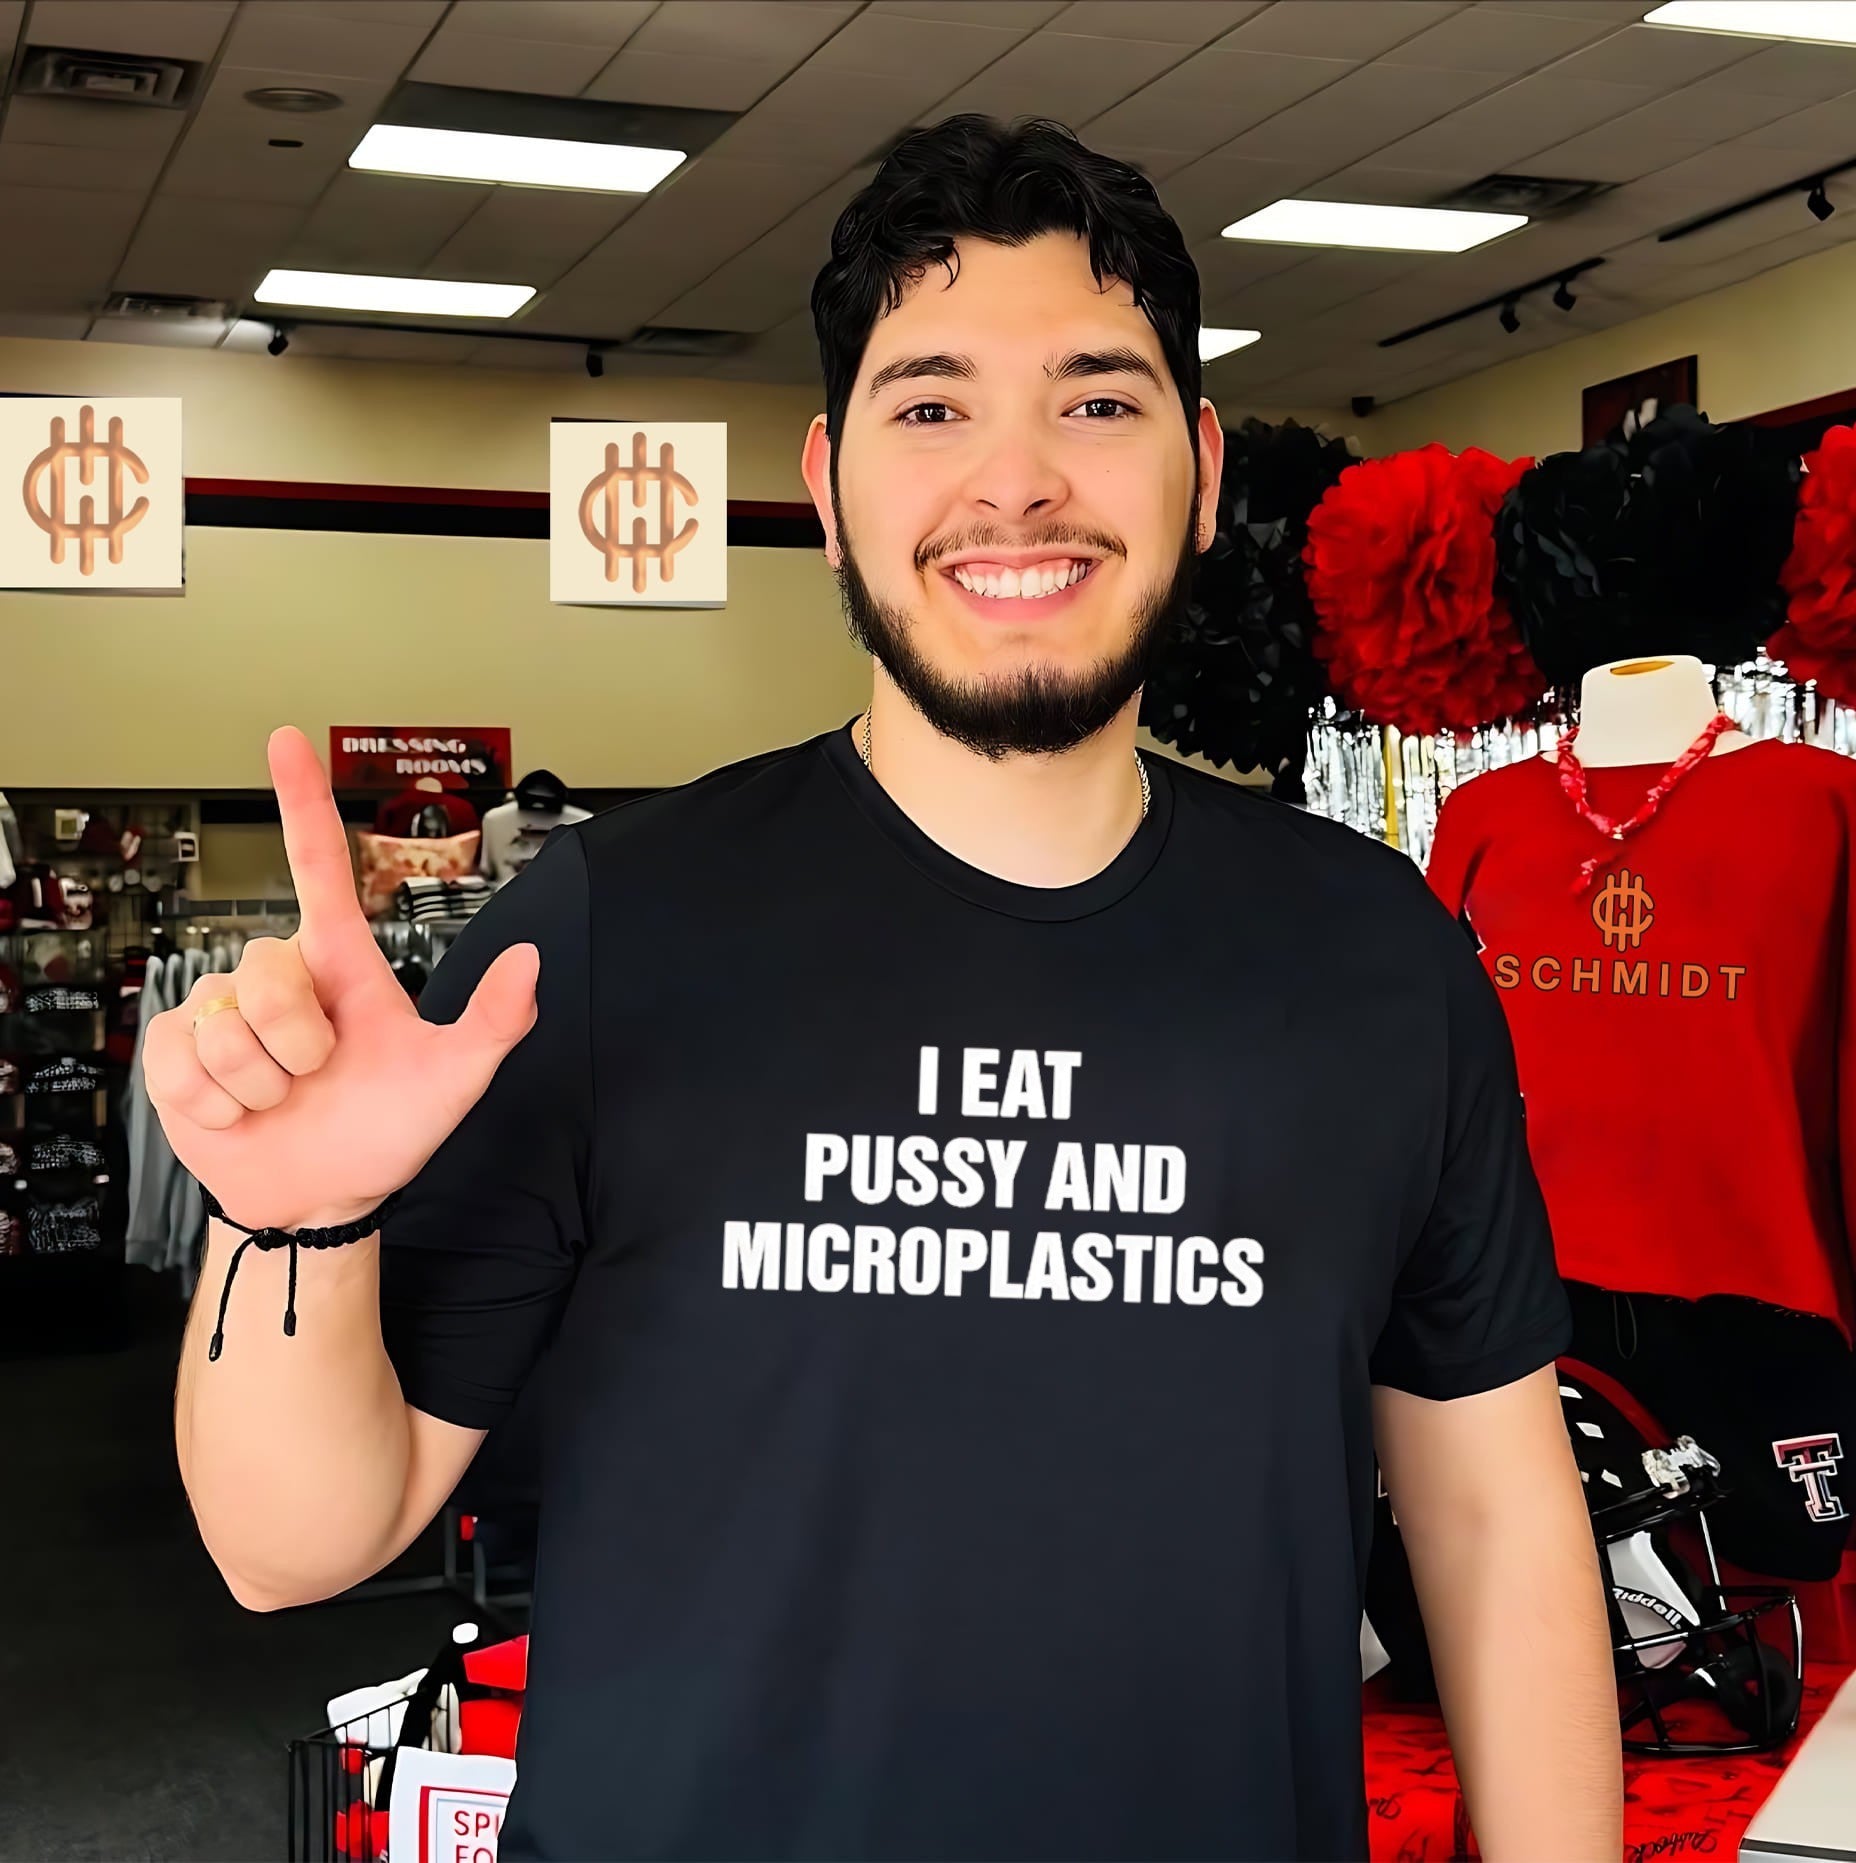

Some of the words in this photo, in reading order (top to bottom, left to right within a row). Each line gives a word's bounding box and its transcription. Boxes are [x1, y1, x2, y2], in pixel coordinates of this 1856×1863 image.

[342, 737, 467, 753] DRESSING
[396, 758, 487, 775] ROOMS
[1494, 953, 1747, 1001] SCHMIDT
[918, 1045, 939, 1115] I
[961, 1047, 1083, 1120] EAT
[804, 1132, 1028, 1209] PUSSY
[1044, 1141, 1187, 1214] AND
[721, 1220, 1265, 1307] MICROPLASTICS
